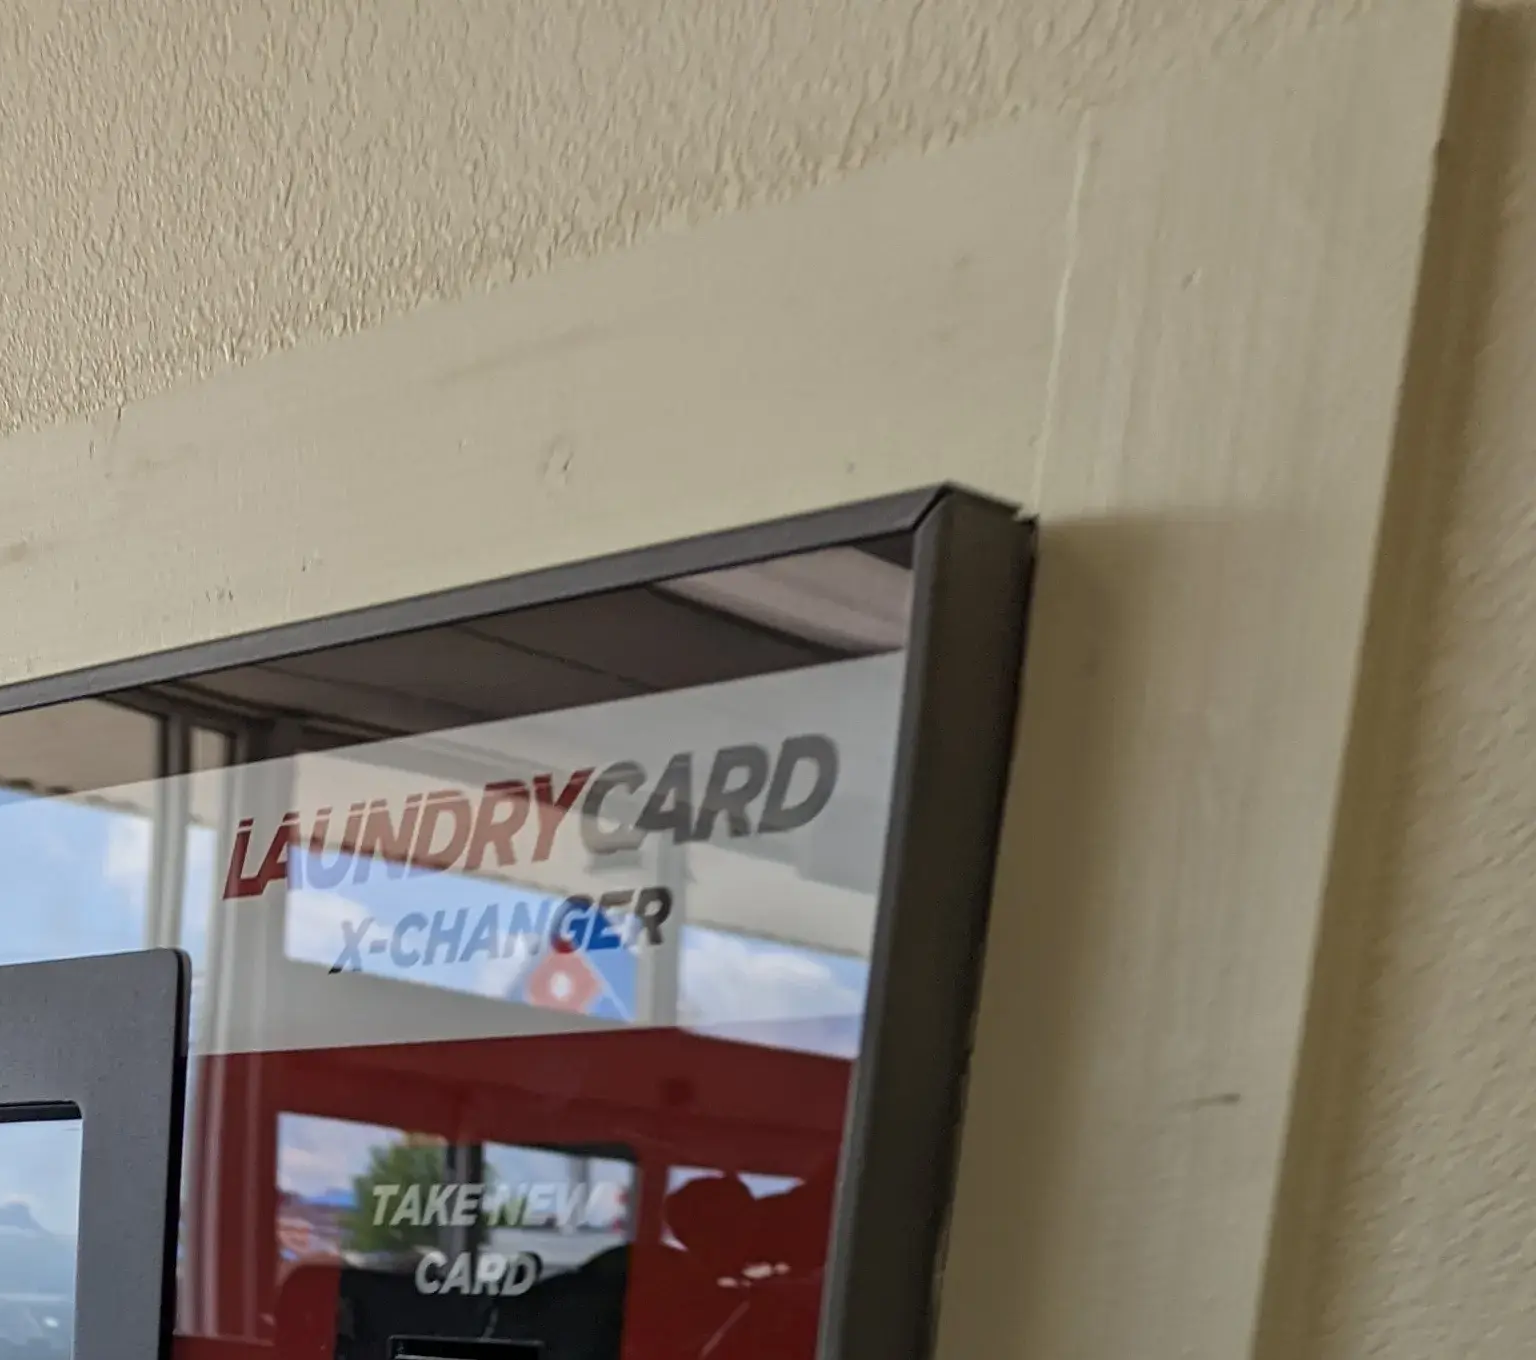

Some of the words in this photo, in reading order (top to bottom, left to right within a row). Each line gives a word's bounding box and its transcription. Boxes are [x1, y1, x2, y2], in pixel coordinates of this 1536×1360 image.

[330, 886, 674, 975] X-CHANGER
[372, 1183, 484, 1227] TAKE
[415, 1250, 540, 1296] CARD
